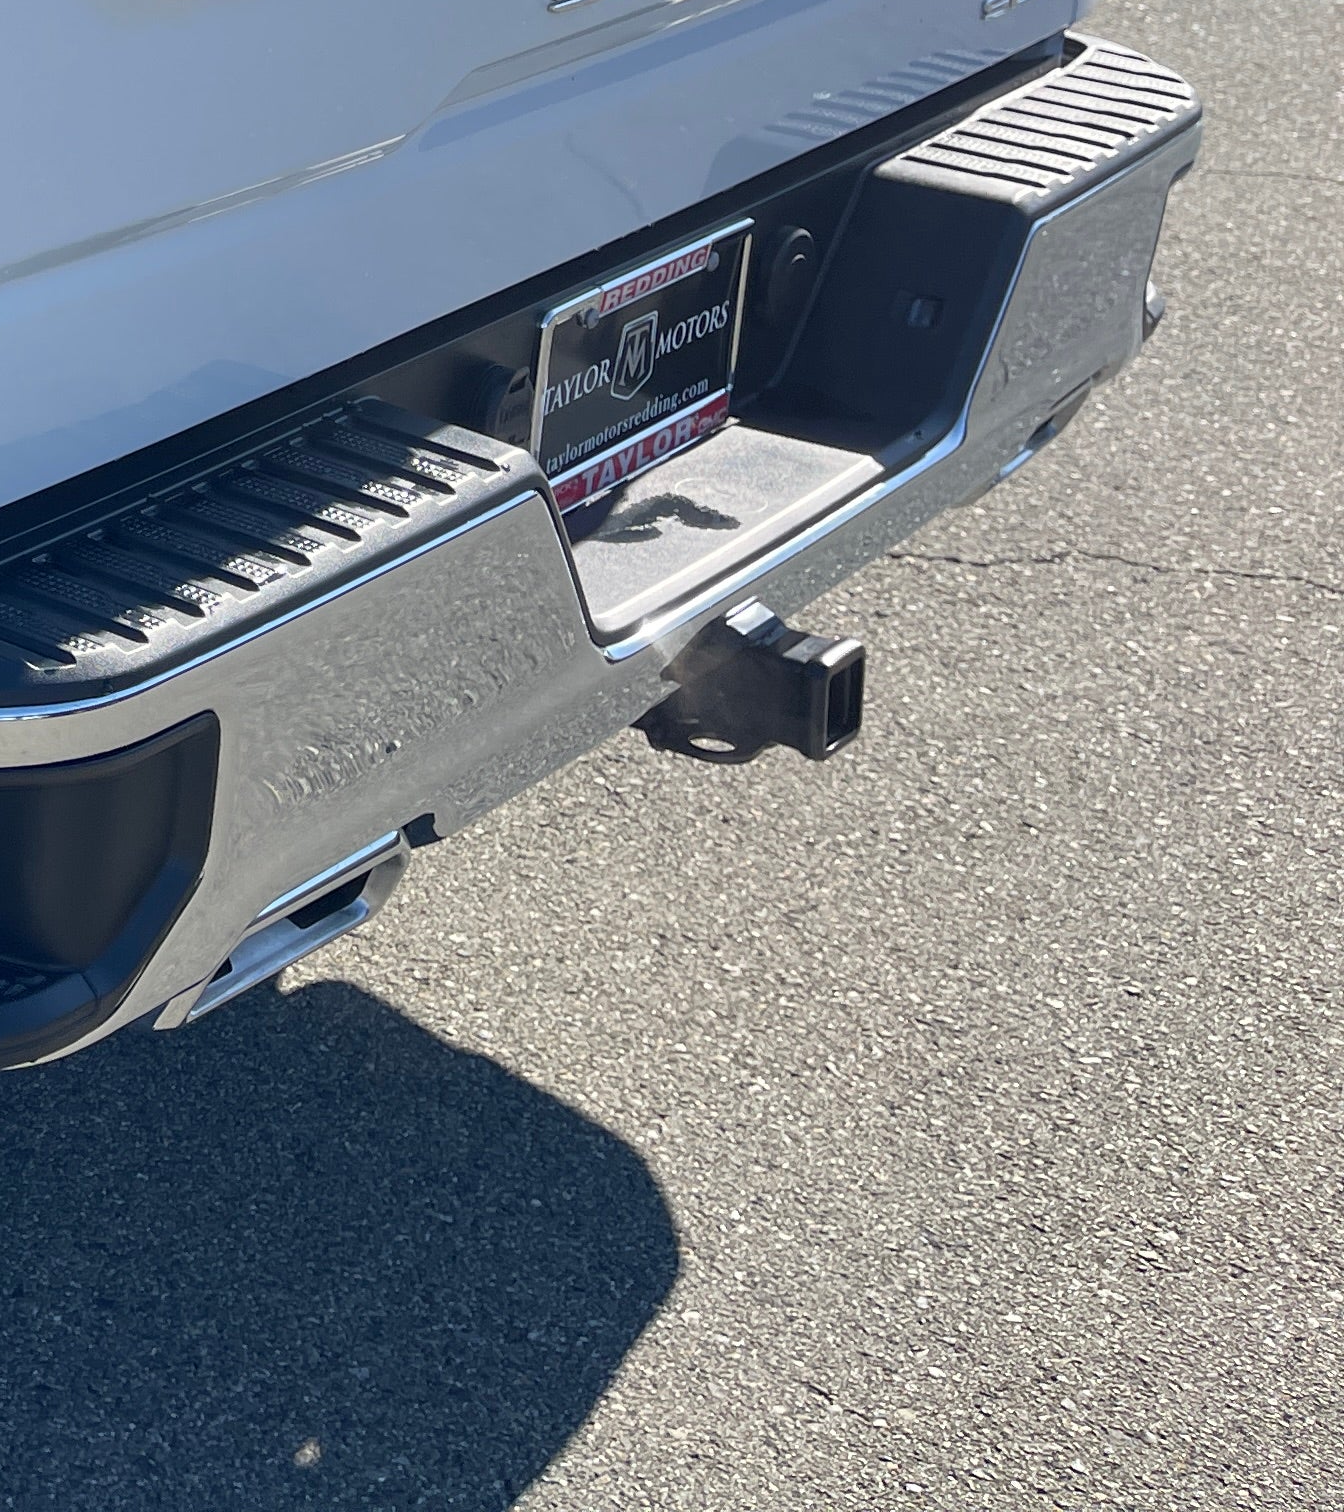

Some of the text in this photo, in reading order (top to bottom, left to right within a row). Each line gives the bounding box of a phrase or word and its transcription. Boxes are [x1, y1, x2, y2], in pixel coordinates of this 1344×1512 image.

[603, 244, 710, 309] REDDING
[542, 358, 612, 417] TAYLOR
[655, 299, 730, 360] MOTORS
[544, 376, 710, 475] taylormotorsredding.com
[581, 415, 695, 497] TAYLOR
